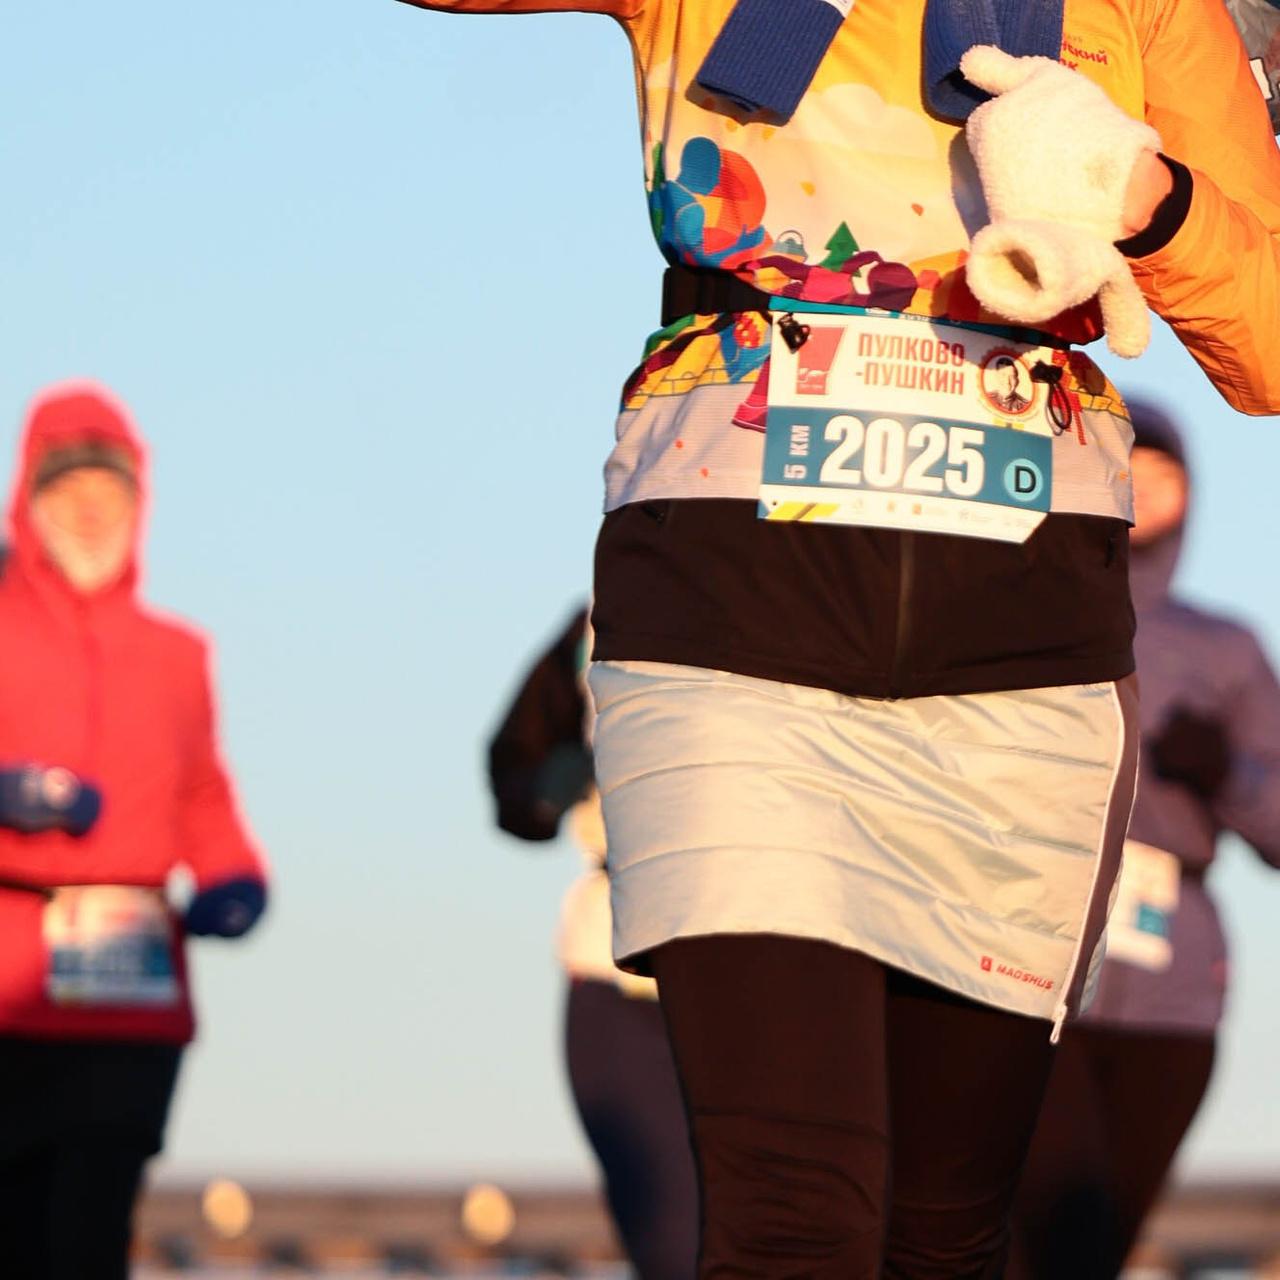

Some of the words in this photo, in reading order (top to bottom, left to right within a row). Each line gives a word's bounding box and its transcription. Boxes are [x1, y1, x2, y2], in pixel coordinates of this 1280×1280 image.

[858, 333, 965, 367] ПУЛКОВО
[856, 362, 965, 395] -ПУШКИН
[784, 464, 808, 480] 5
[818, 414, 985, 497] 2025
[1014, 465, 1037, 494] D
